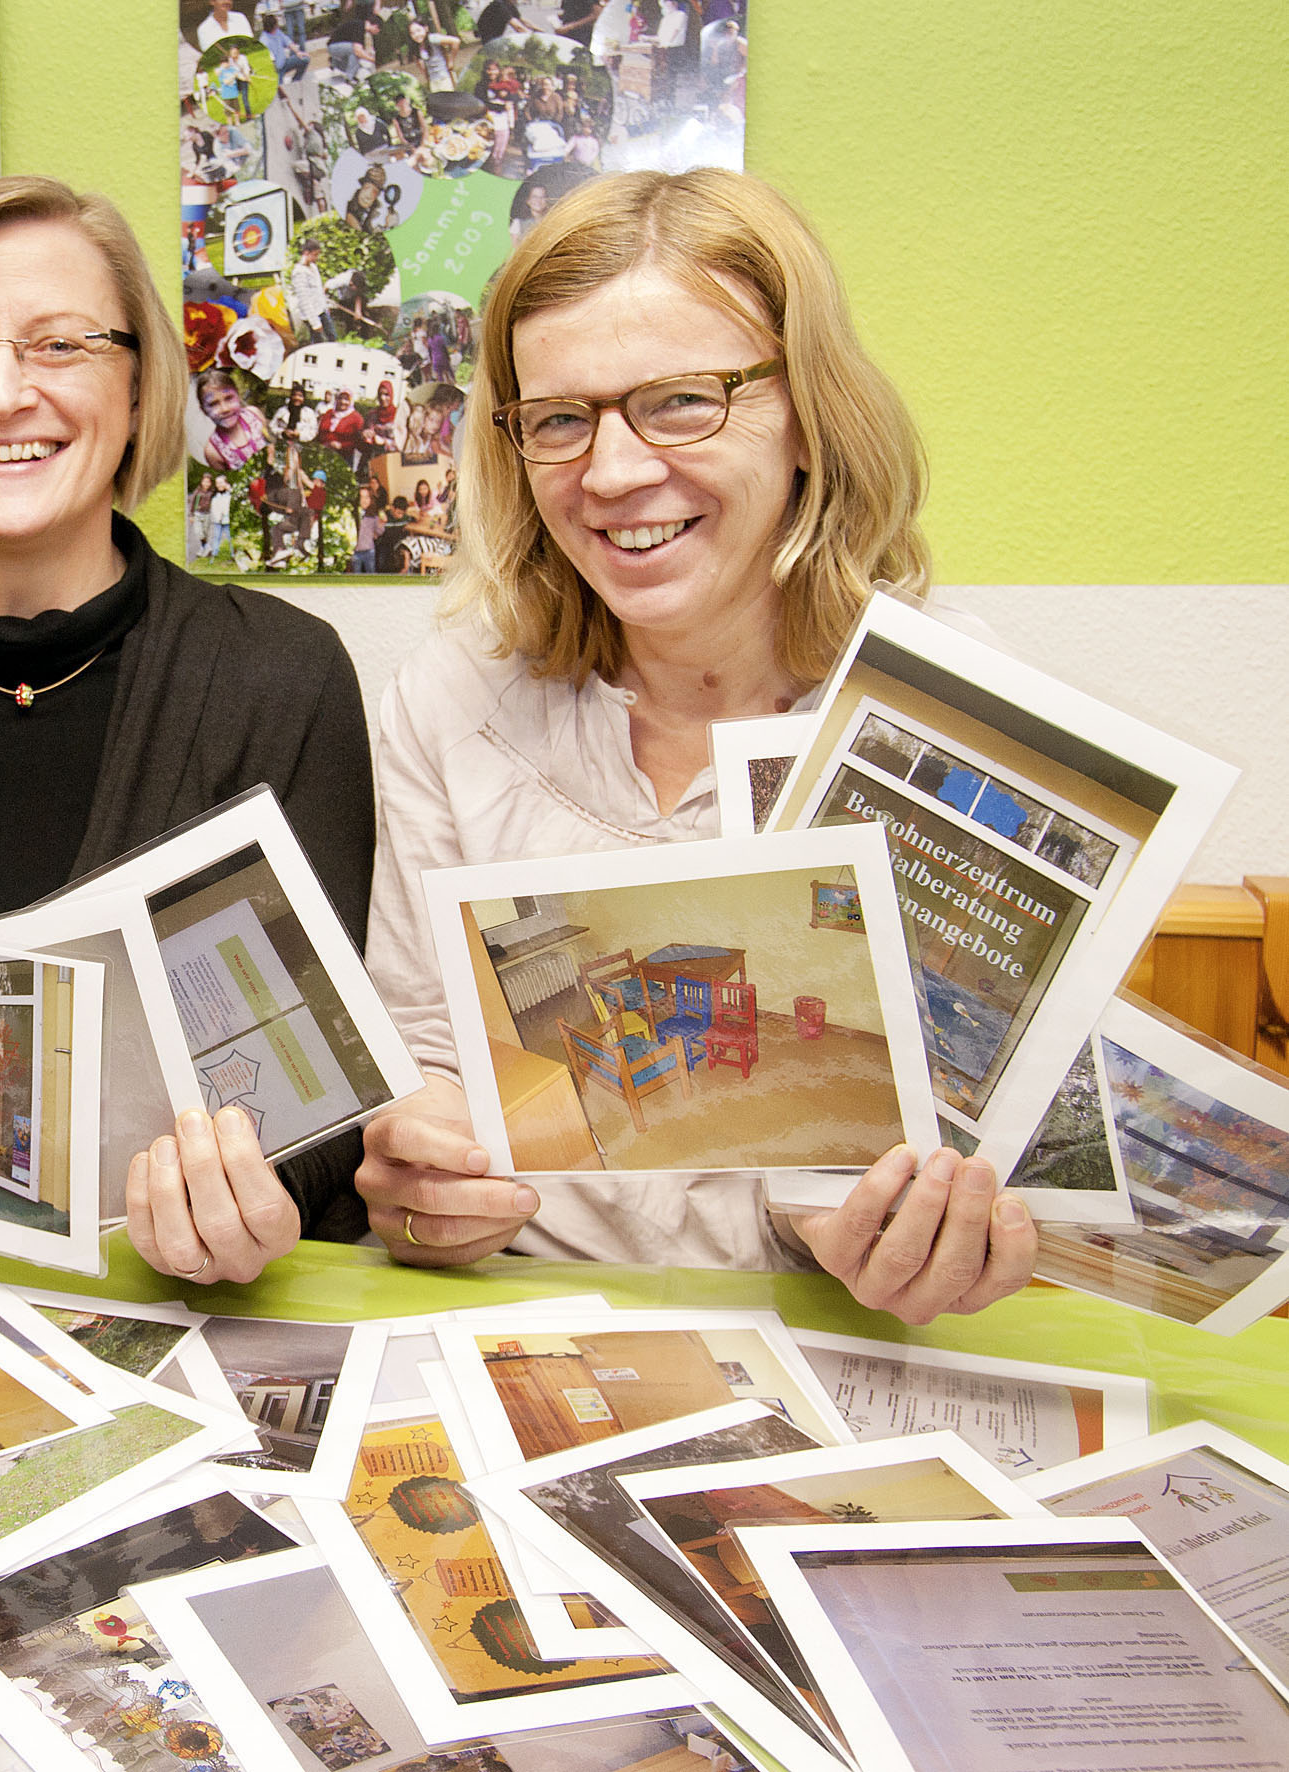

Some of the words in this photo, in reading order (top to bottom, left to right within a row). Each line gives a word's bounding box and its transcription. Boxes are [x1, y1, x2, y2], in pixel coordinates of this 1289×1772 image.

[402, 180, 470, 276] Sommer
[444, 210, 494, 275] 2009
[844, 790, 1057, 926] Bewohnerzentrum
[890, 848, 1023, 944] ialberatung
[233, 953, 243, 968] Was
[241, 969, 250, 980] wir
[248, 980, 258, 995] sind
[897, 892, 1023, 978] enangebote
[1181, 1528, 1223, 1552] Mutter
[1219, 1518, 1245, 1538] und
[1243, 1510, 1273, 1530] Kind
